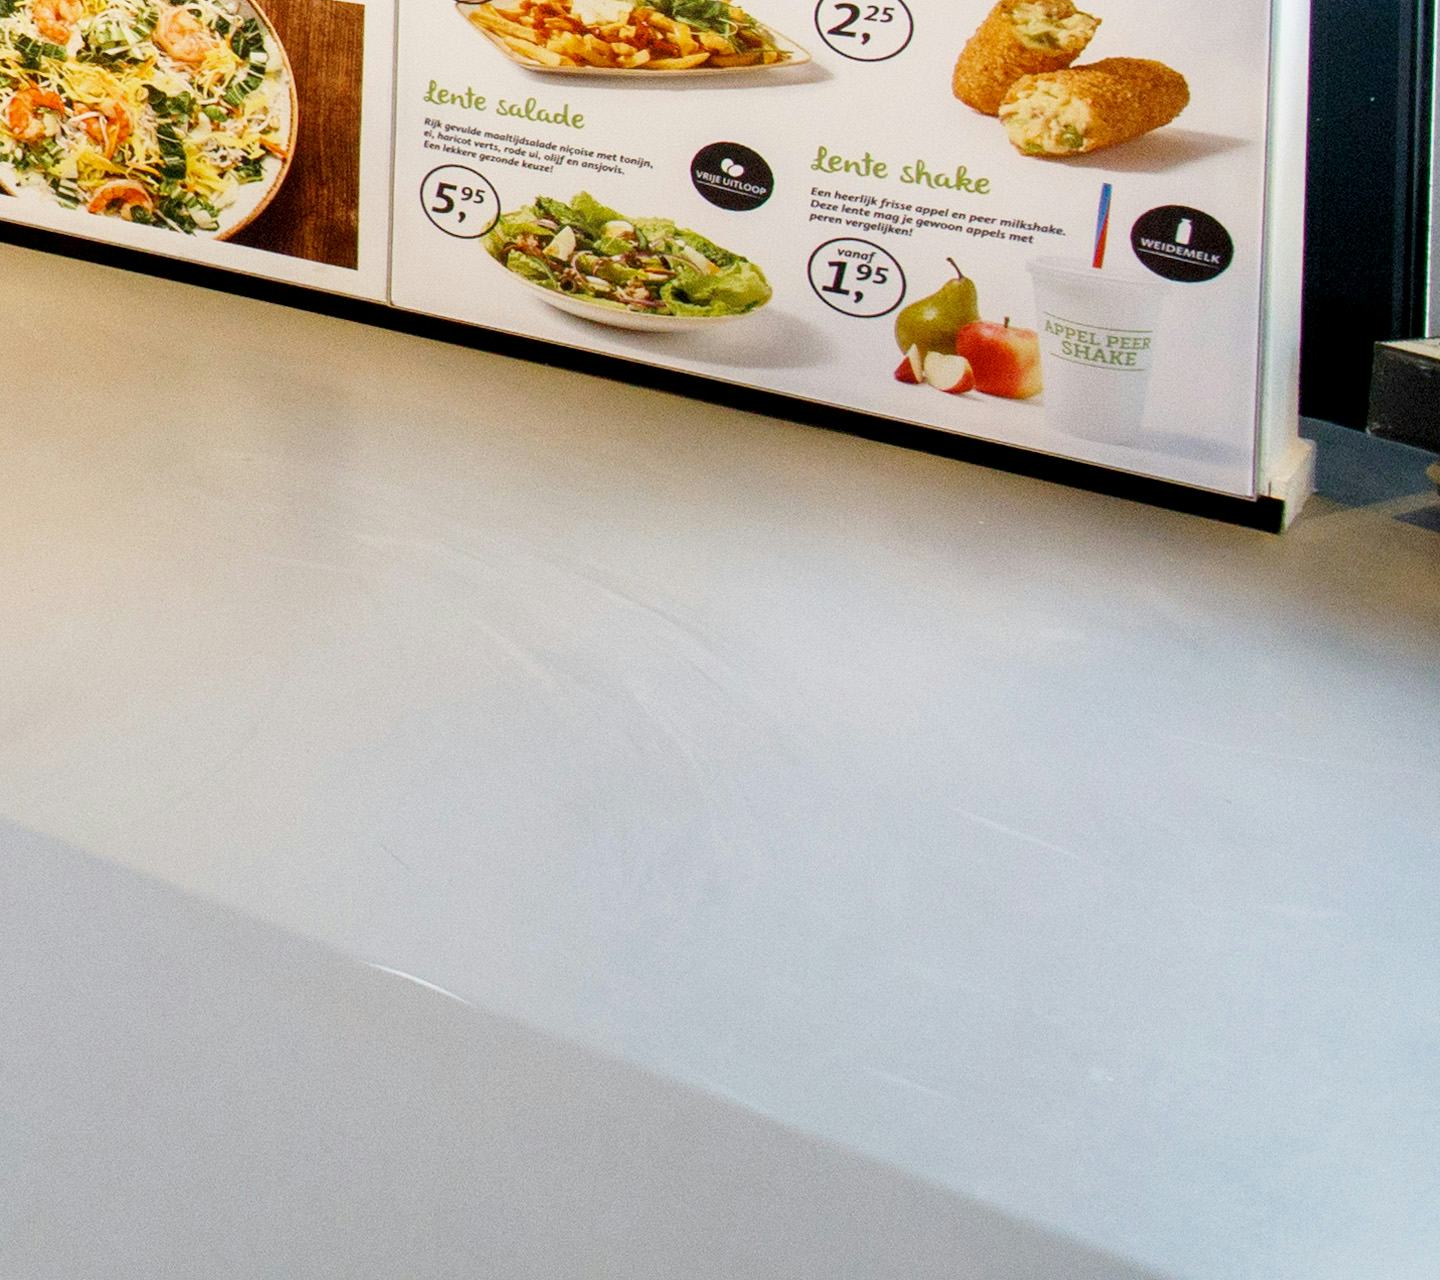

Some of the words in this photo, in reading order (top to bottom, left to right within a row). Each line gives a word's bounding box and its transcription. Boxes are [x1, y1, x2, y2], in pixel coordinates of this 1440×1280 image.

[827, 3, 894, 46] 2,25
[423, 80, 487, 112] Lente
[496, 97, 585, 129] salade
[696, 168, 719, 186] VRIJE
[721, 176, 768, 197] UITLOOP
[810, 145, 888, 180] Lente
[899, 160, 992, 196] shake
[431, 181, 485, 223] 5,95
[837, 246, 877, 265] vanaf
[1140, 236, 1221, 265] WEIDEMELK
[821, 260, 889, 305] 1,95
[1044, 320, 1100, 349] APPEL
[1106, 333, 1152, 351] PEER
[1061, 340, 1138, 367] SHAKE
